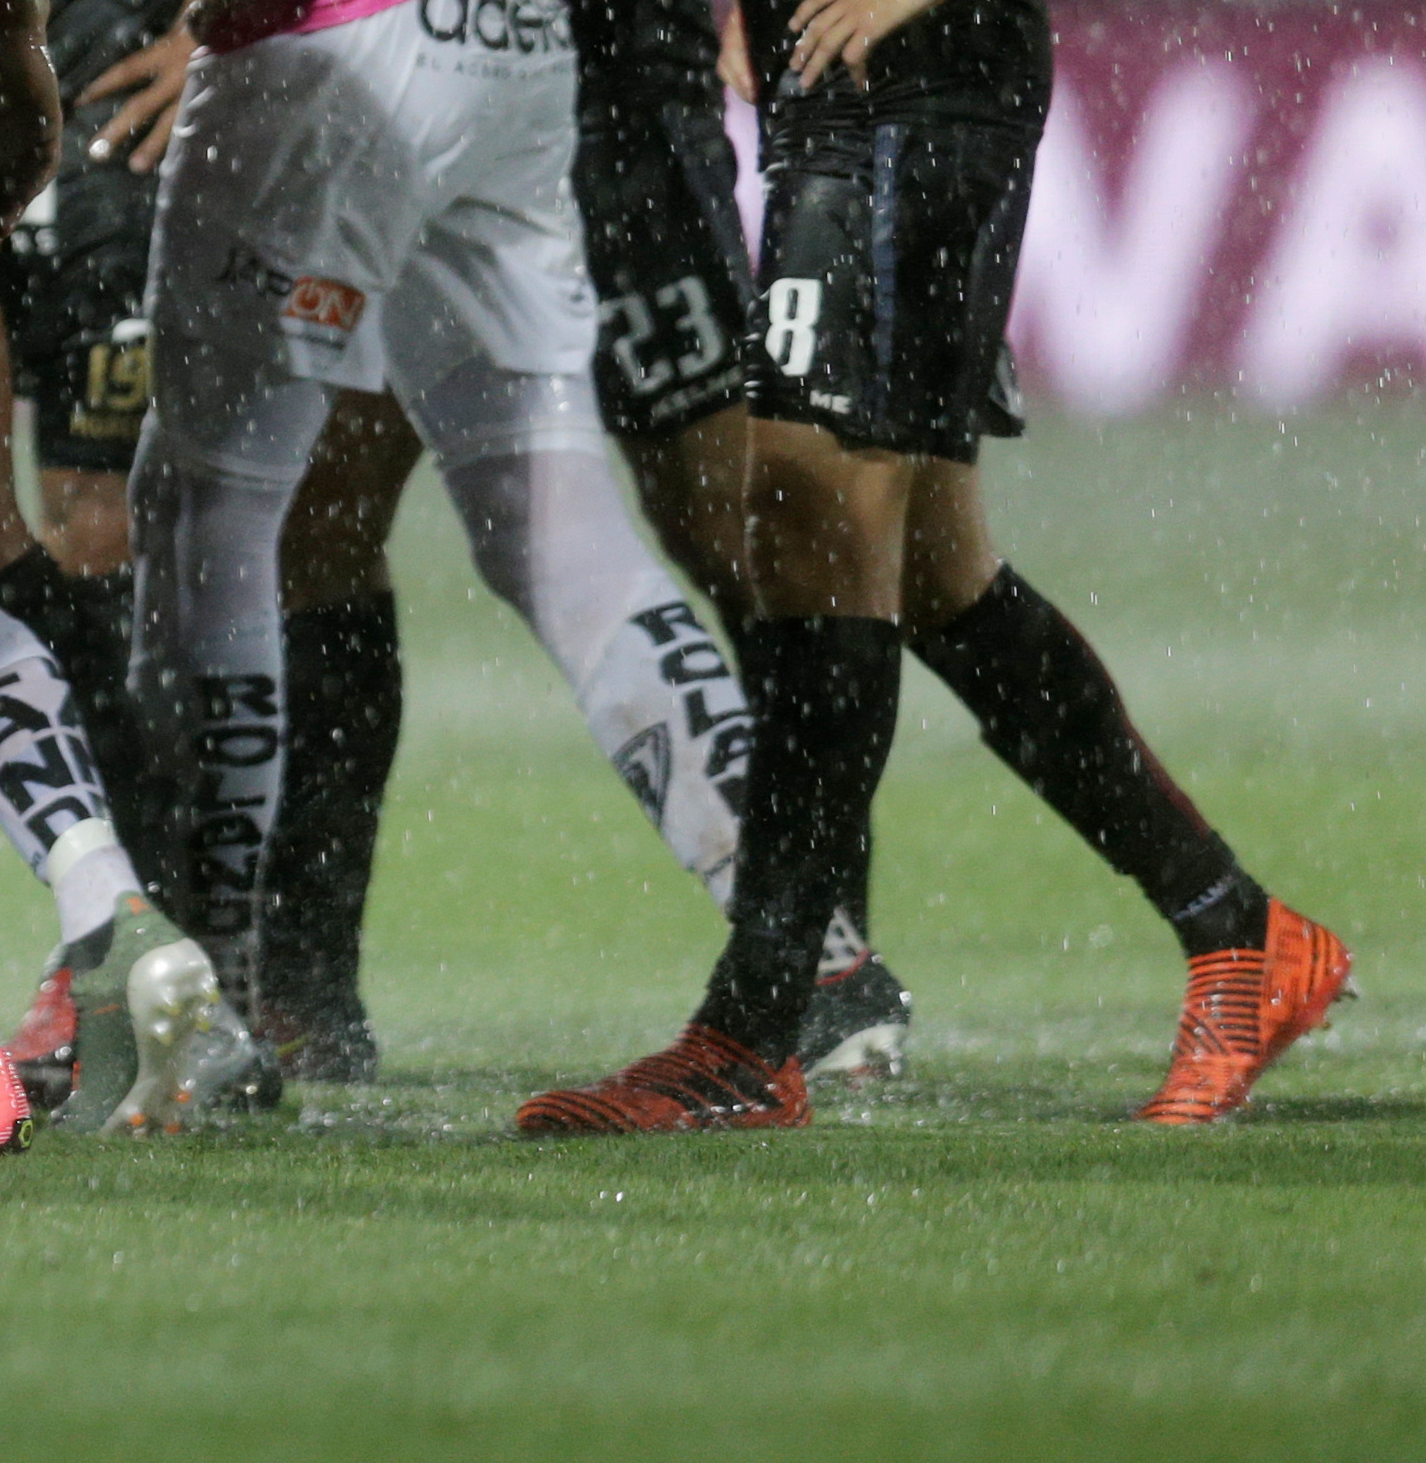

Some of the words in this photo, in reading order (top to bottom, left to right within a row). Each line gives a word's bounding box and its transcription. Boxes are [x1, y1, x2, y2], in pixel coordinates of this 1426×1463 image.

[88, 344, 152, 409] 19
[594, 276, 724, 395] 23
[766, 277, 821, 377] 8
